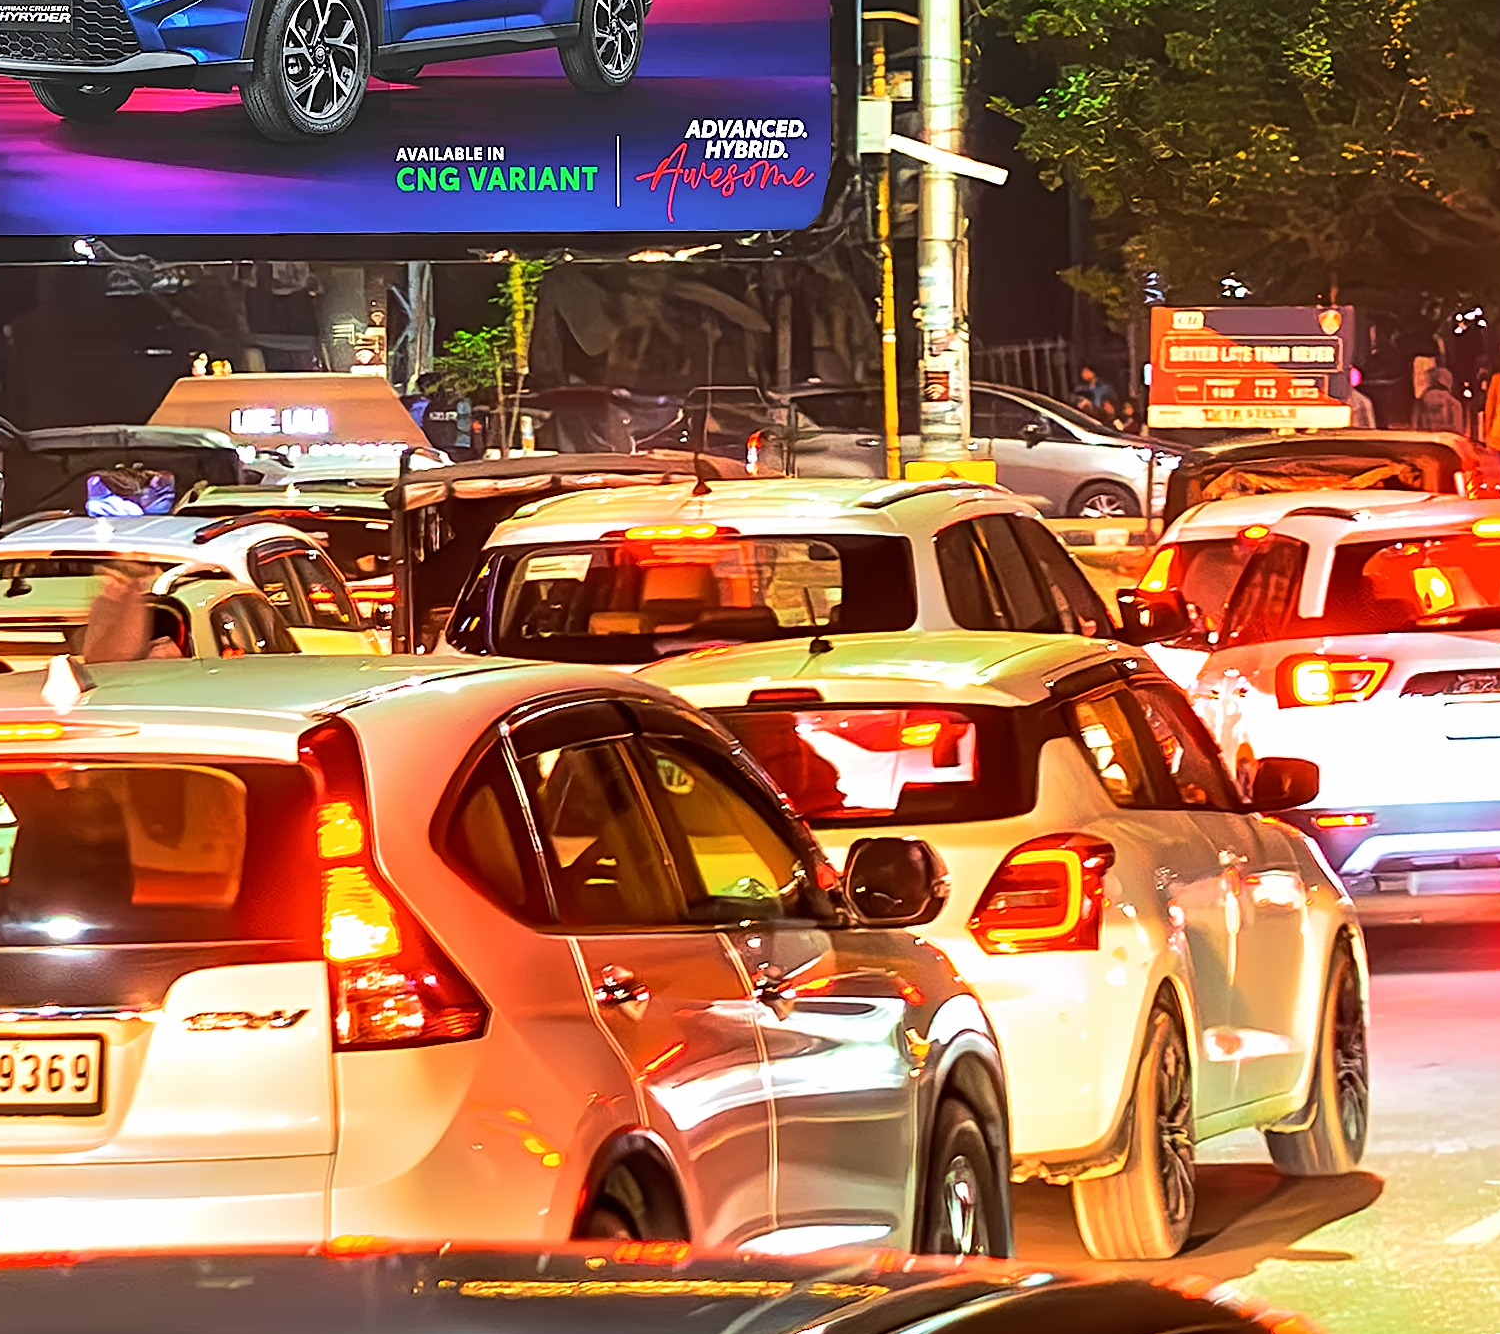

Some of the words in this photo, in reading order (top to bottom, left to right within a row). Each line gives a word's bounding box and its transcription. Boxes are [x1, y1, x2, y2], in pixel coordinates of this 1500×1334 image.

[0, 12, 71, 23] HYRYDER
[685, 119, 808, 139] ADVANCED.
[396, 147, 481, 161] AVAILABLE
[487, 147, 504, 161] IN
[705, 140, 789, 159] HYBRID.
[396, 167, 460, 191] CNG
[467, 166, 597, 191] VARIANT
[637, 143, 814, 223] Awesome
